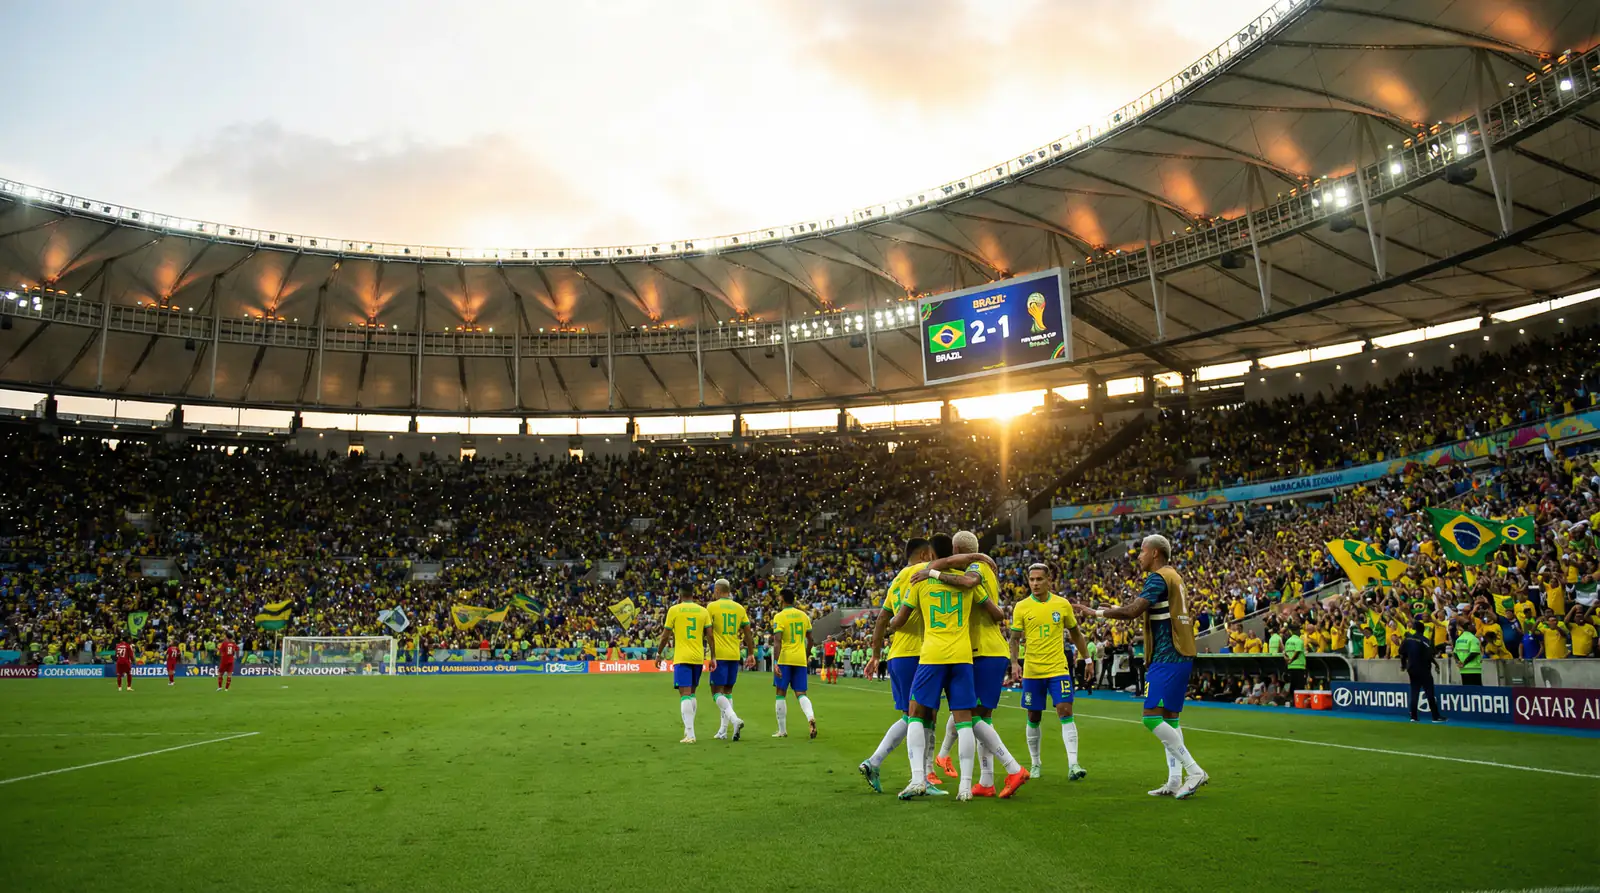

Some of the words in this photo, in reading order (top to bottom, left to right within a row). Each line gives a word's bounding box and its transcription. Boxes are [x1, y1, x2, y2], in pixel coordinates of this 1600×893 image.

[970, 315, 1010, 344] 2-1
[935, 351, 962, 363] BRAZIL
[929, 591, 963, 628] 24
[686, 617, 697, 640] 2
[721, 613, 737, 636] 19
[789, 622, 804, 644] 19
[1039, 624, 1050, 638] 12
[1060, 680, 1071, 693] 12
[1354, 690, 1408, 709] HYUNDAI
[1440, 693, 1509, 714] HYUNDAI
[1515, 695, 1577, 720] QATAR
